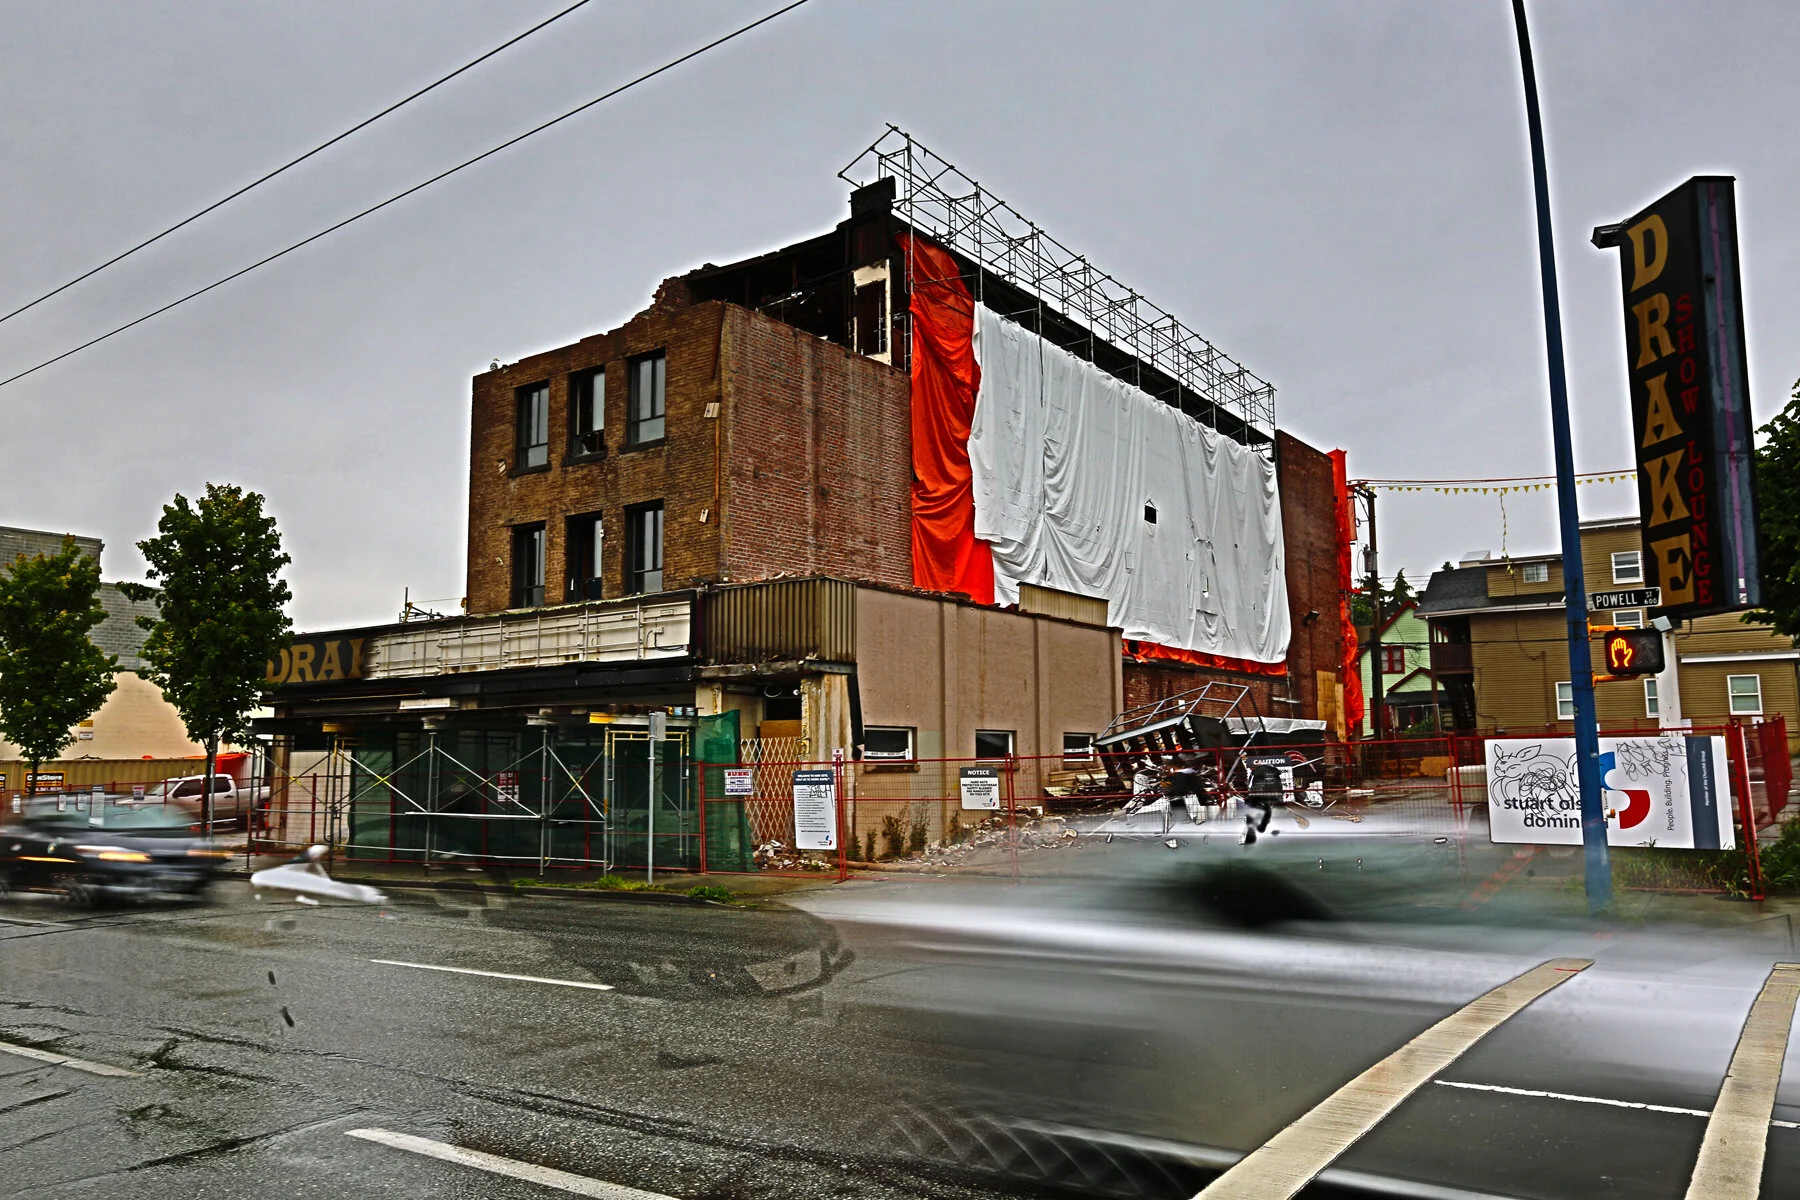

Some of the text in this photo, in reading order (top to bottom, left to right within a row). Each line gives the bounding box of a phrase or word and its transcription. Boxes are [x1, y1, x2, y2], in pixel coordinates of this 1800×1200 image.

[1676, 294, 1699, 414] SHOW
[1626, 213, 1694, 608] DRAKE
[1687, 441, 1713, 604] LOUNGE
[1596, 593, 1638, 607] POWELL
[1504, 796, 1581, 810] stuart ols
[1664, 778, 1673, 807] Building.
[1665, 807, 1675, 831] People.
